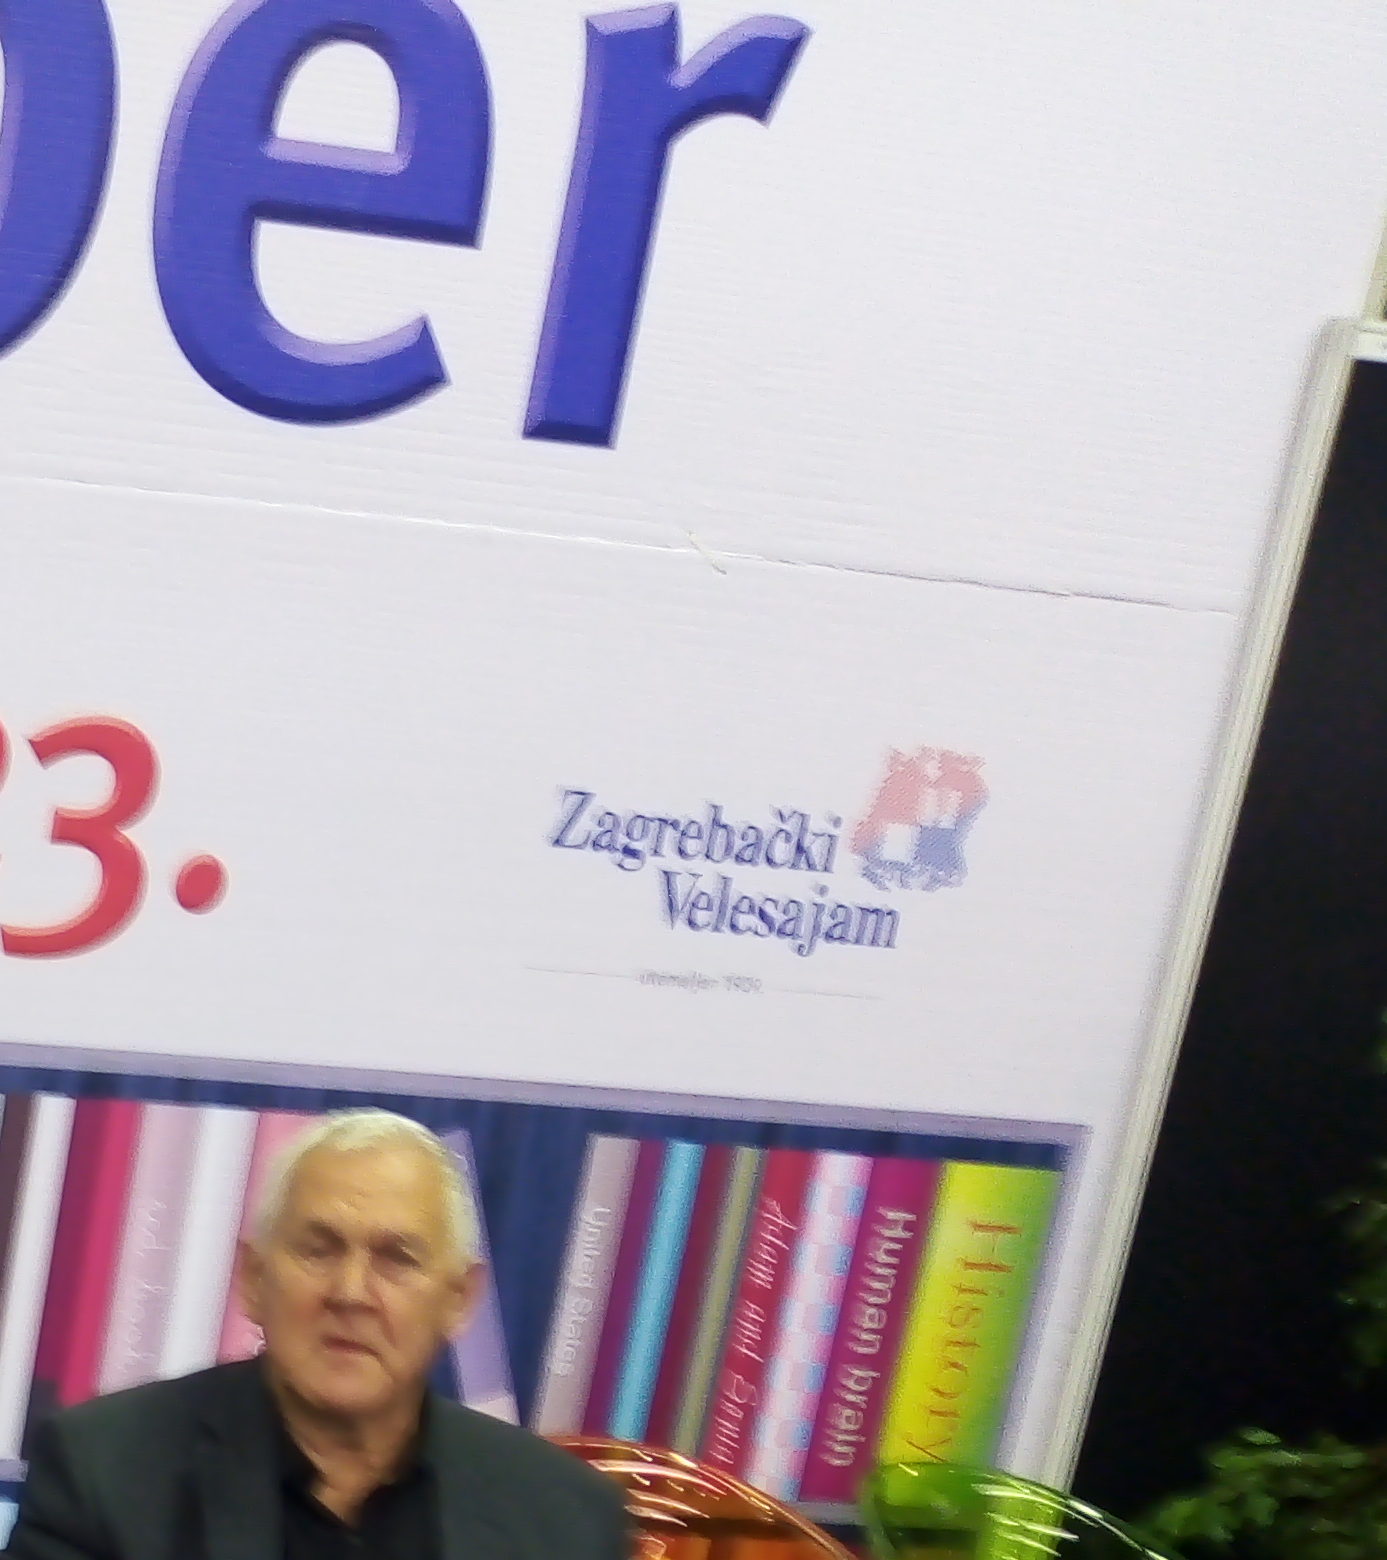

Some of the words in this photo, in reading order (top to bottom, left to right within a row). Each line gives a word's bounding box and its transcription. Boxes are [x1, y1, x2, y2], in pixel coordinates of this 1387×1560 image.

[543, 784, 845, 876] Zagrebački
[657, 869, 902, 957] Velesajam
[574, 1205, 613, 1291] United
[745, 1198, 798, 1291] Adam
[849, 1206, 918, 1357] Human
[551, 1293, 597, 1379] States
[730, 1298, 770, 1365] and
[905, 1218, 1022, 1464] History
[824, 1362, 883, 1469] brain
